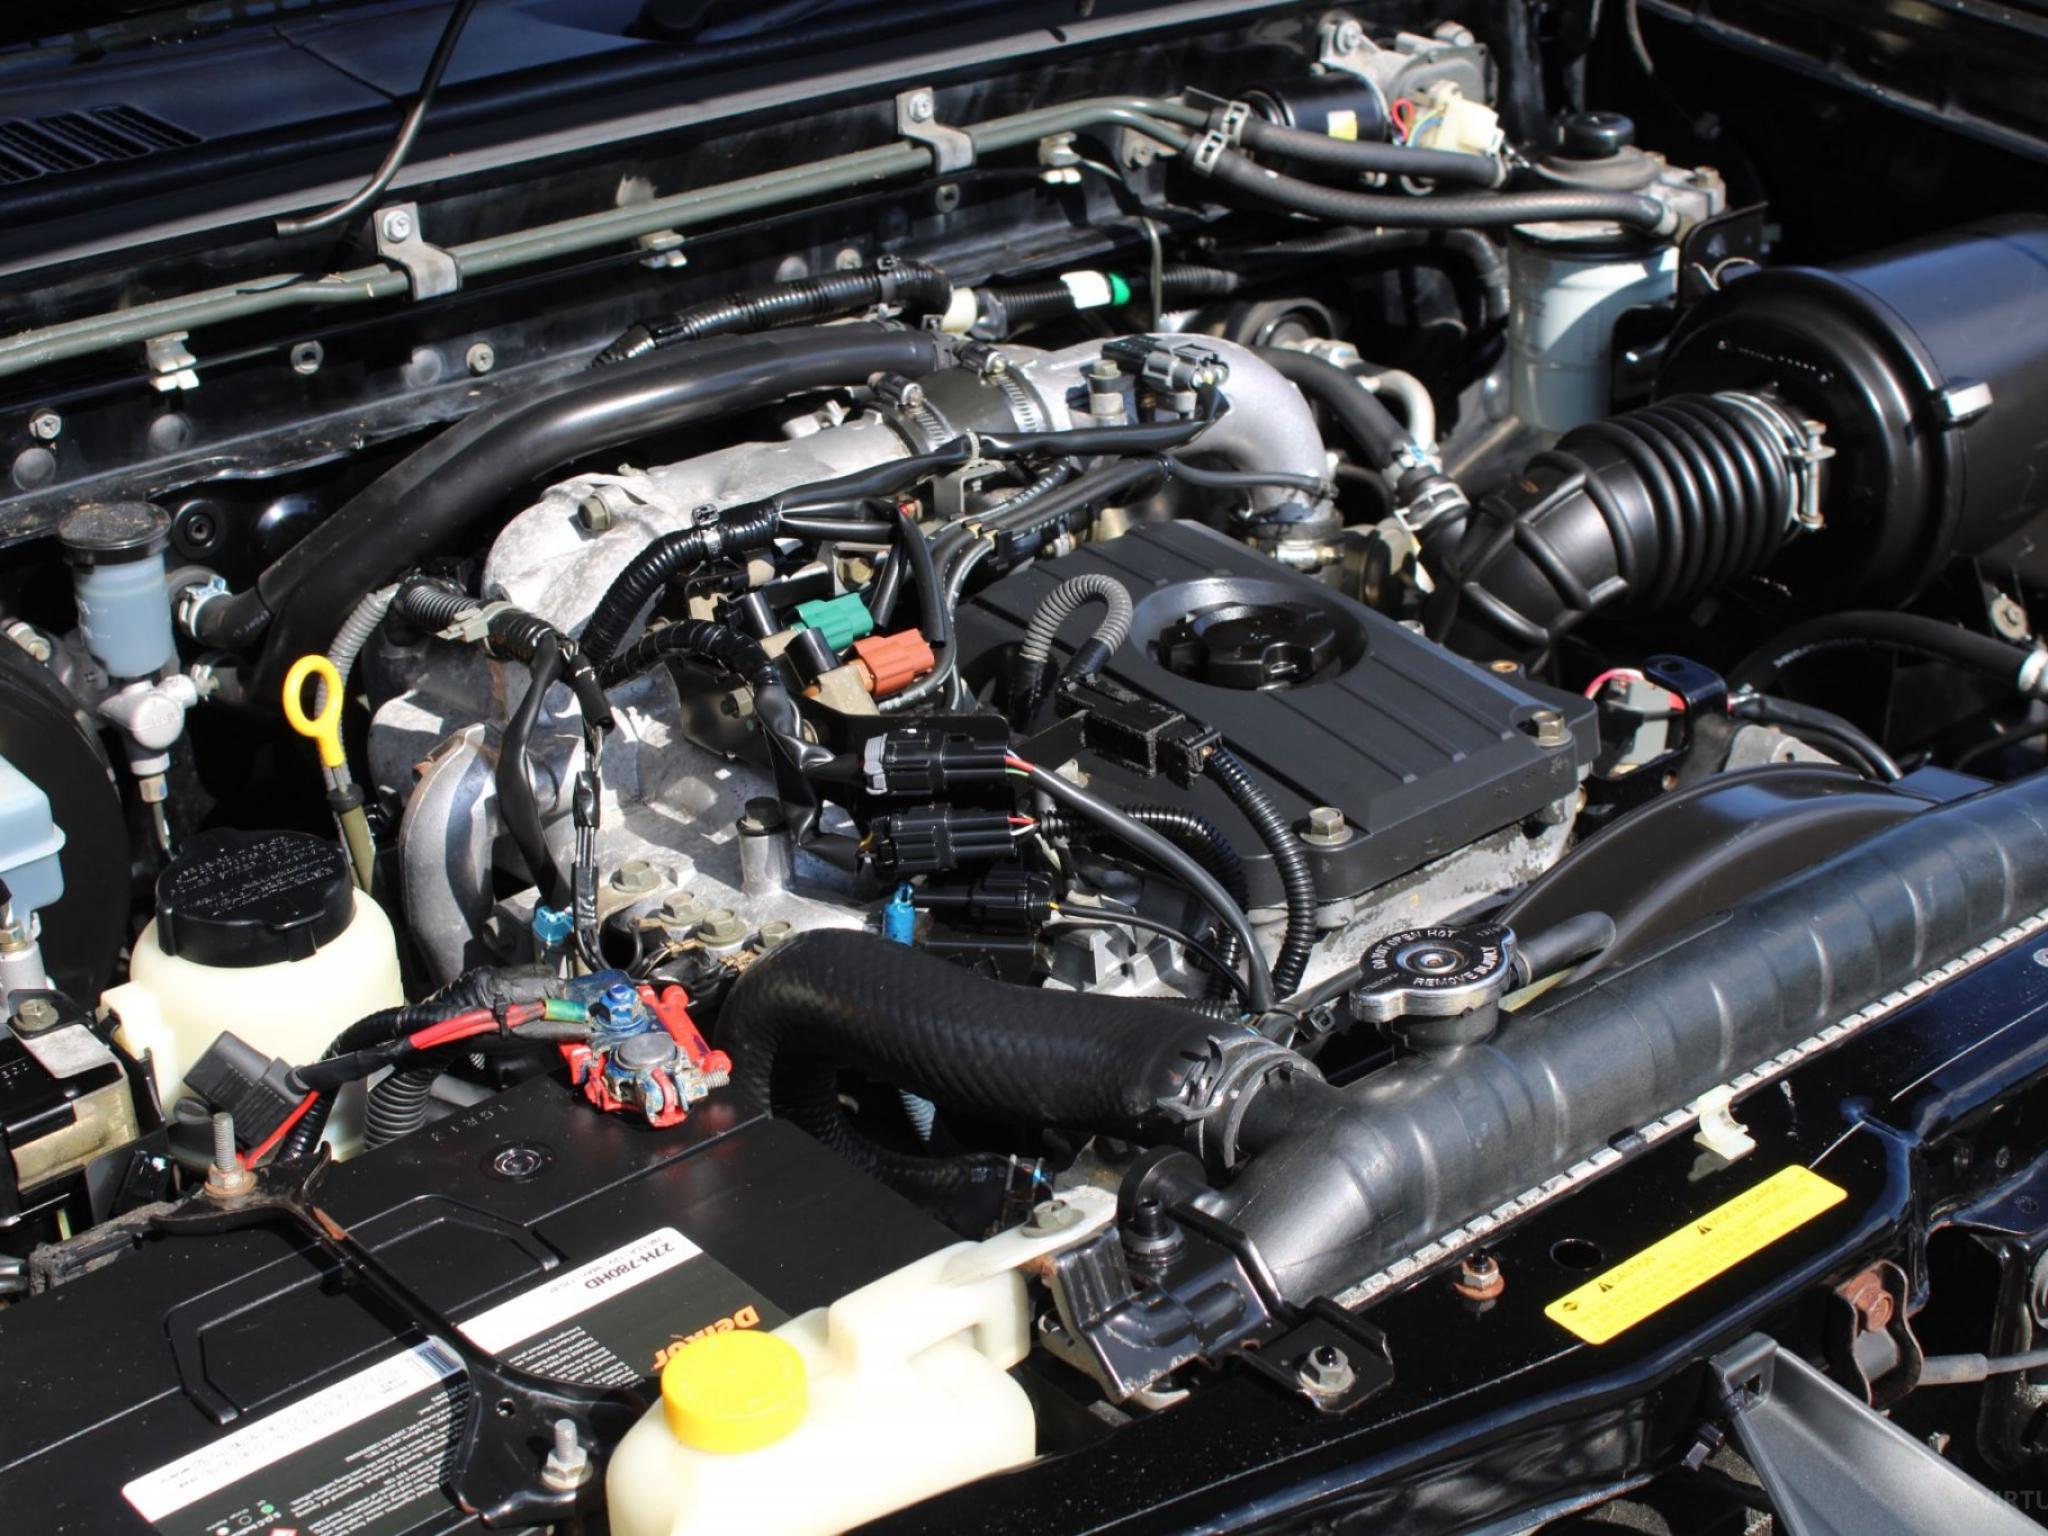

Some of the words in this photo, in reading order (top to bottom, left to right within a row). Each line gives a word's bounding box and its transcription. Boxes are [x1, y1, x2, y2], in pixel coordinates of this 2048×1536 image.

[1427, 929, 1457, 937] HOT
[1413, 971, 1478, 987] REMOVE
[585, 1242, 674, 1289] 27H-780HD
